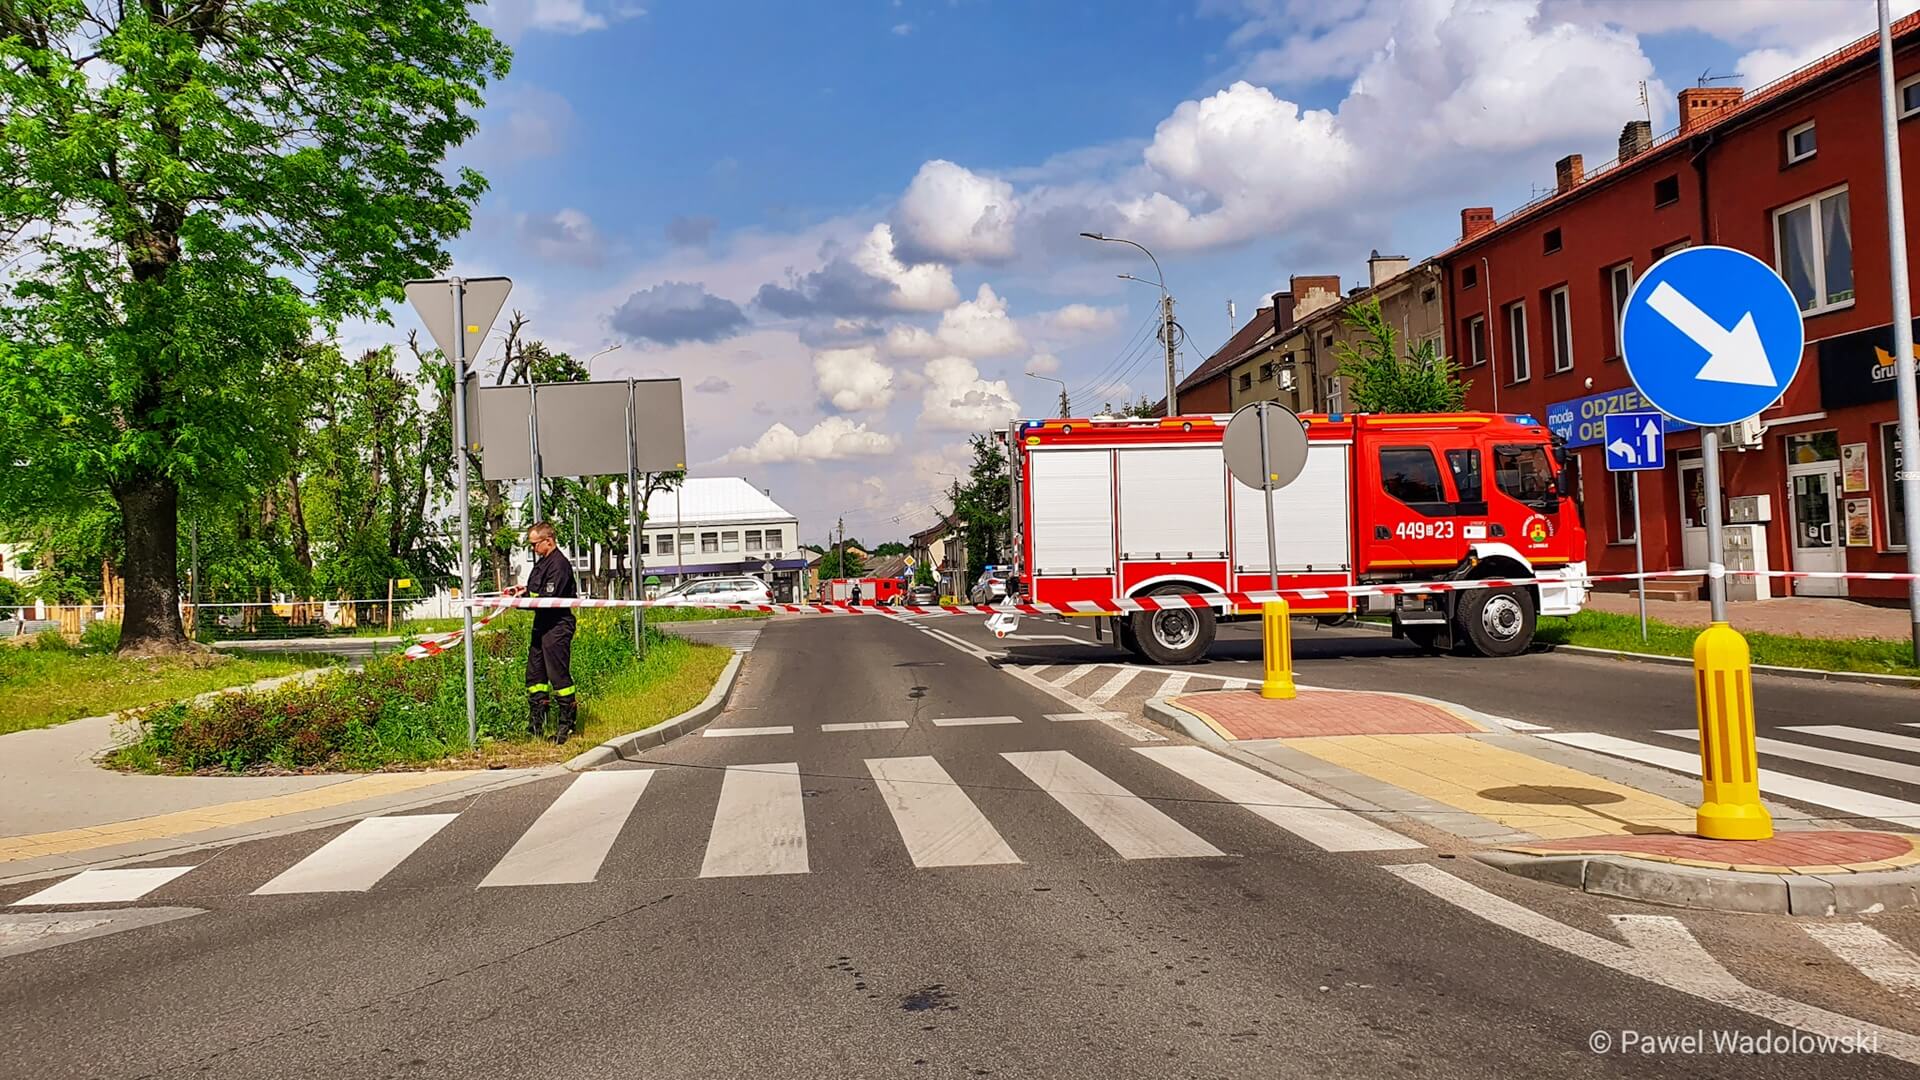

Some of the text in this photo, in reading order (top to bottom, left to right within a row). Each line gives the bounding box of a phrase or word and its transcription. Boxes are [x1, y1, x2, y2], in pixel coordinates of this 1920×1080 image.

[1549, 408, 1574, 425] moda
[1396, 521, 1425, 540] 449
[1434, 520, 1455, 539] 23
